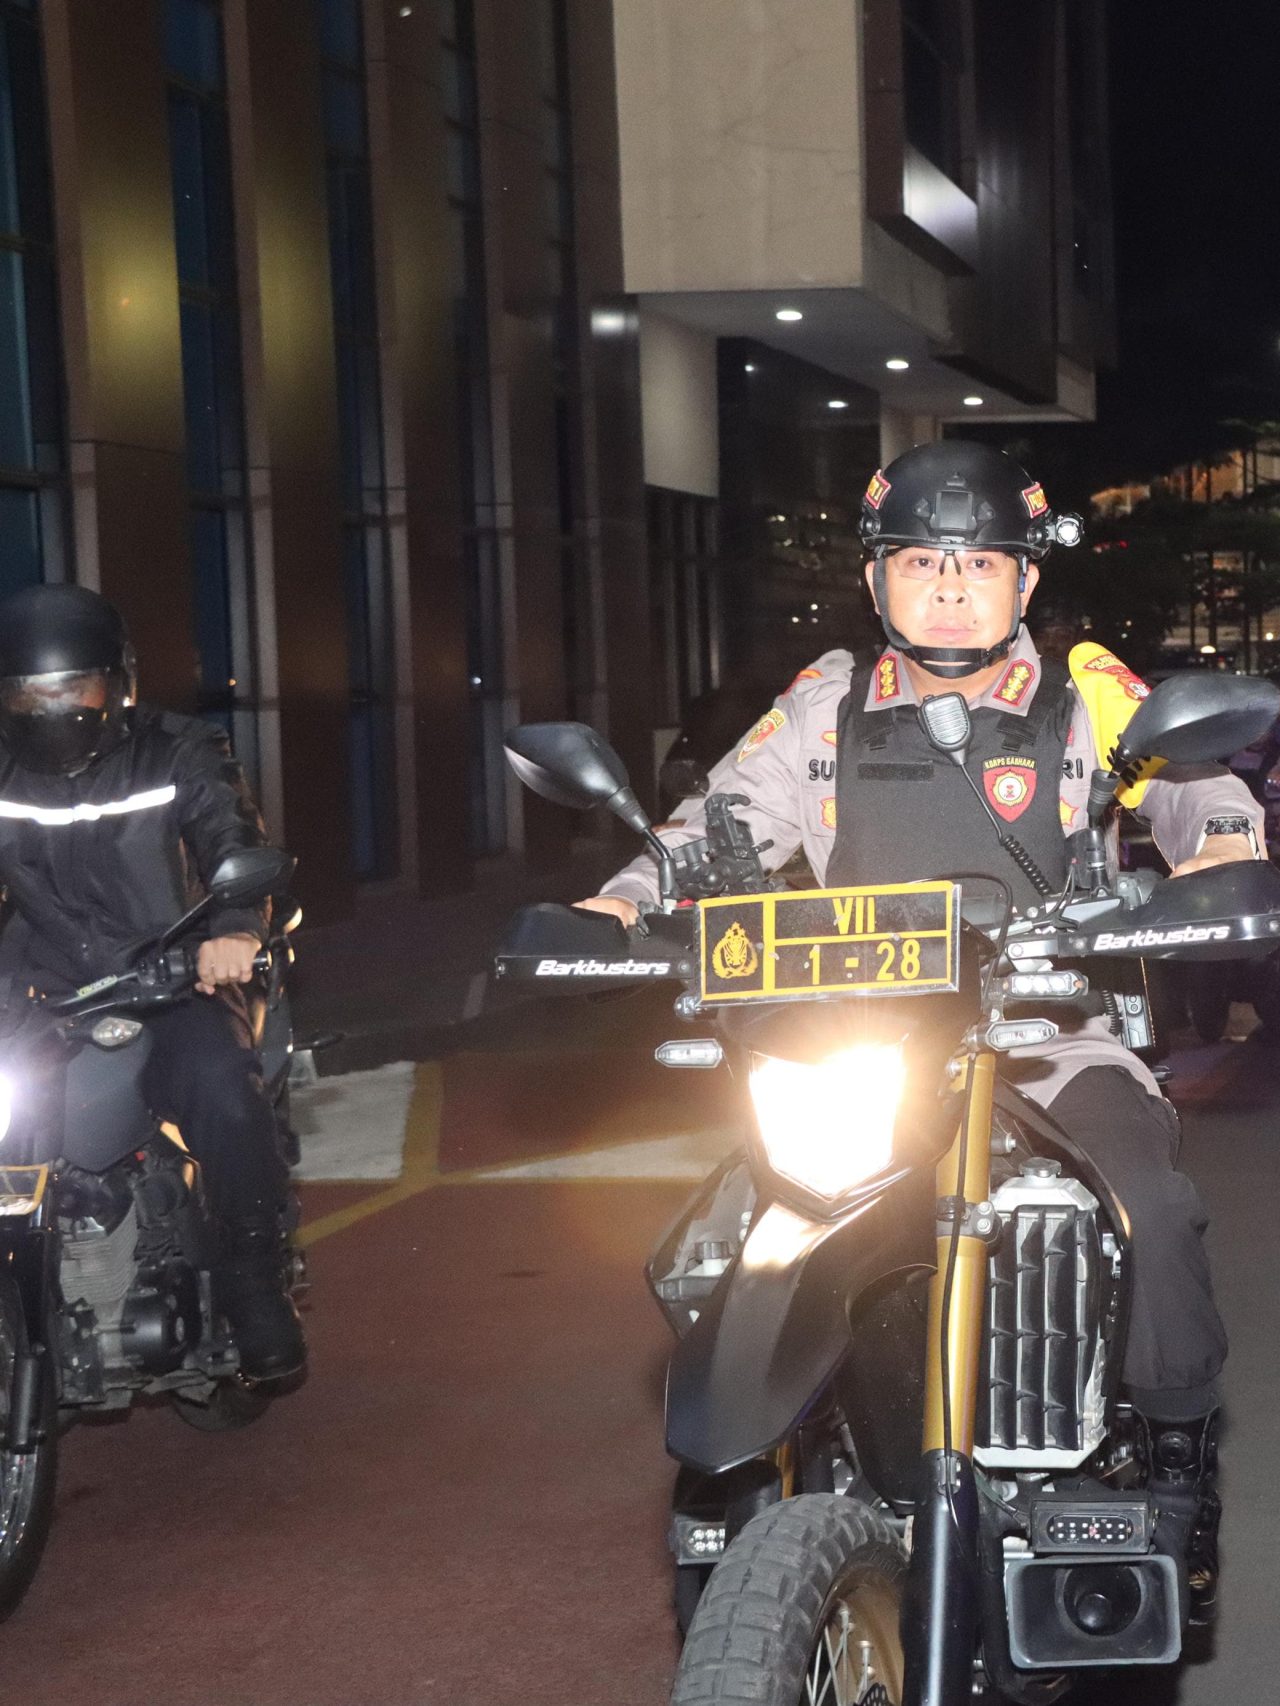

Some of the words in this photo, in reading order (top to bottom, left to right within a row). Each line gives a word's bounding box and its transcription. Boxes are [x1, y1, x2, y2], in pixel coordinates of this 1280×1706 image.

[808, 758, 836, 782] SU
[832, 896, 876, 934] VII
[1093, 926, 1231, 951] Barkbusters
[535, 959, 670, 976] Barkbusters
[809, 944, 820, 985] 1
[876, 938, 921, 981] 28
